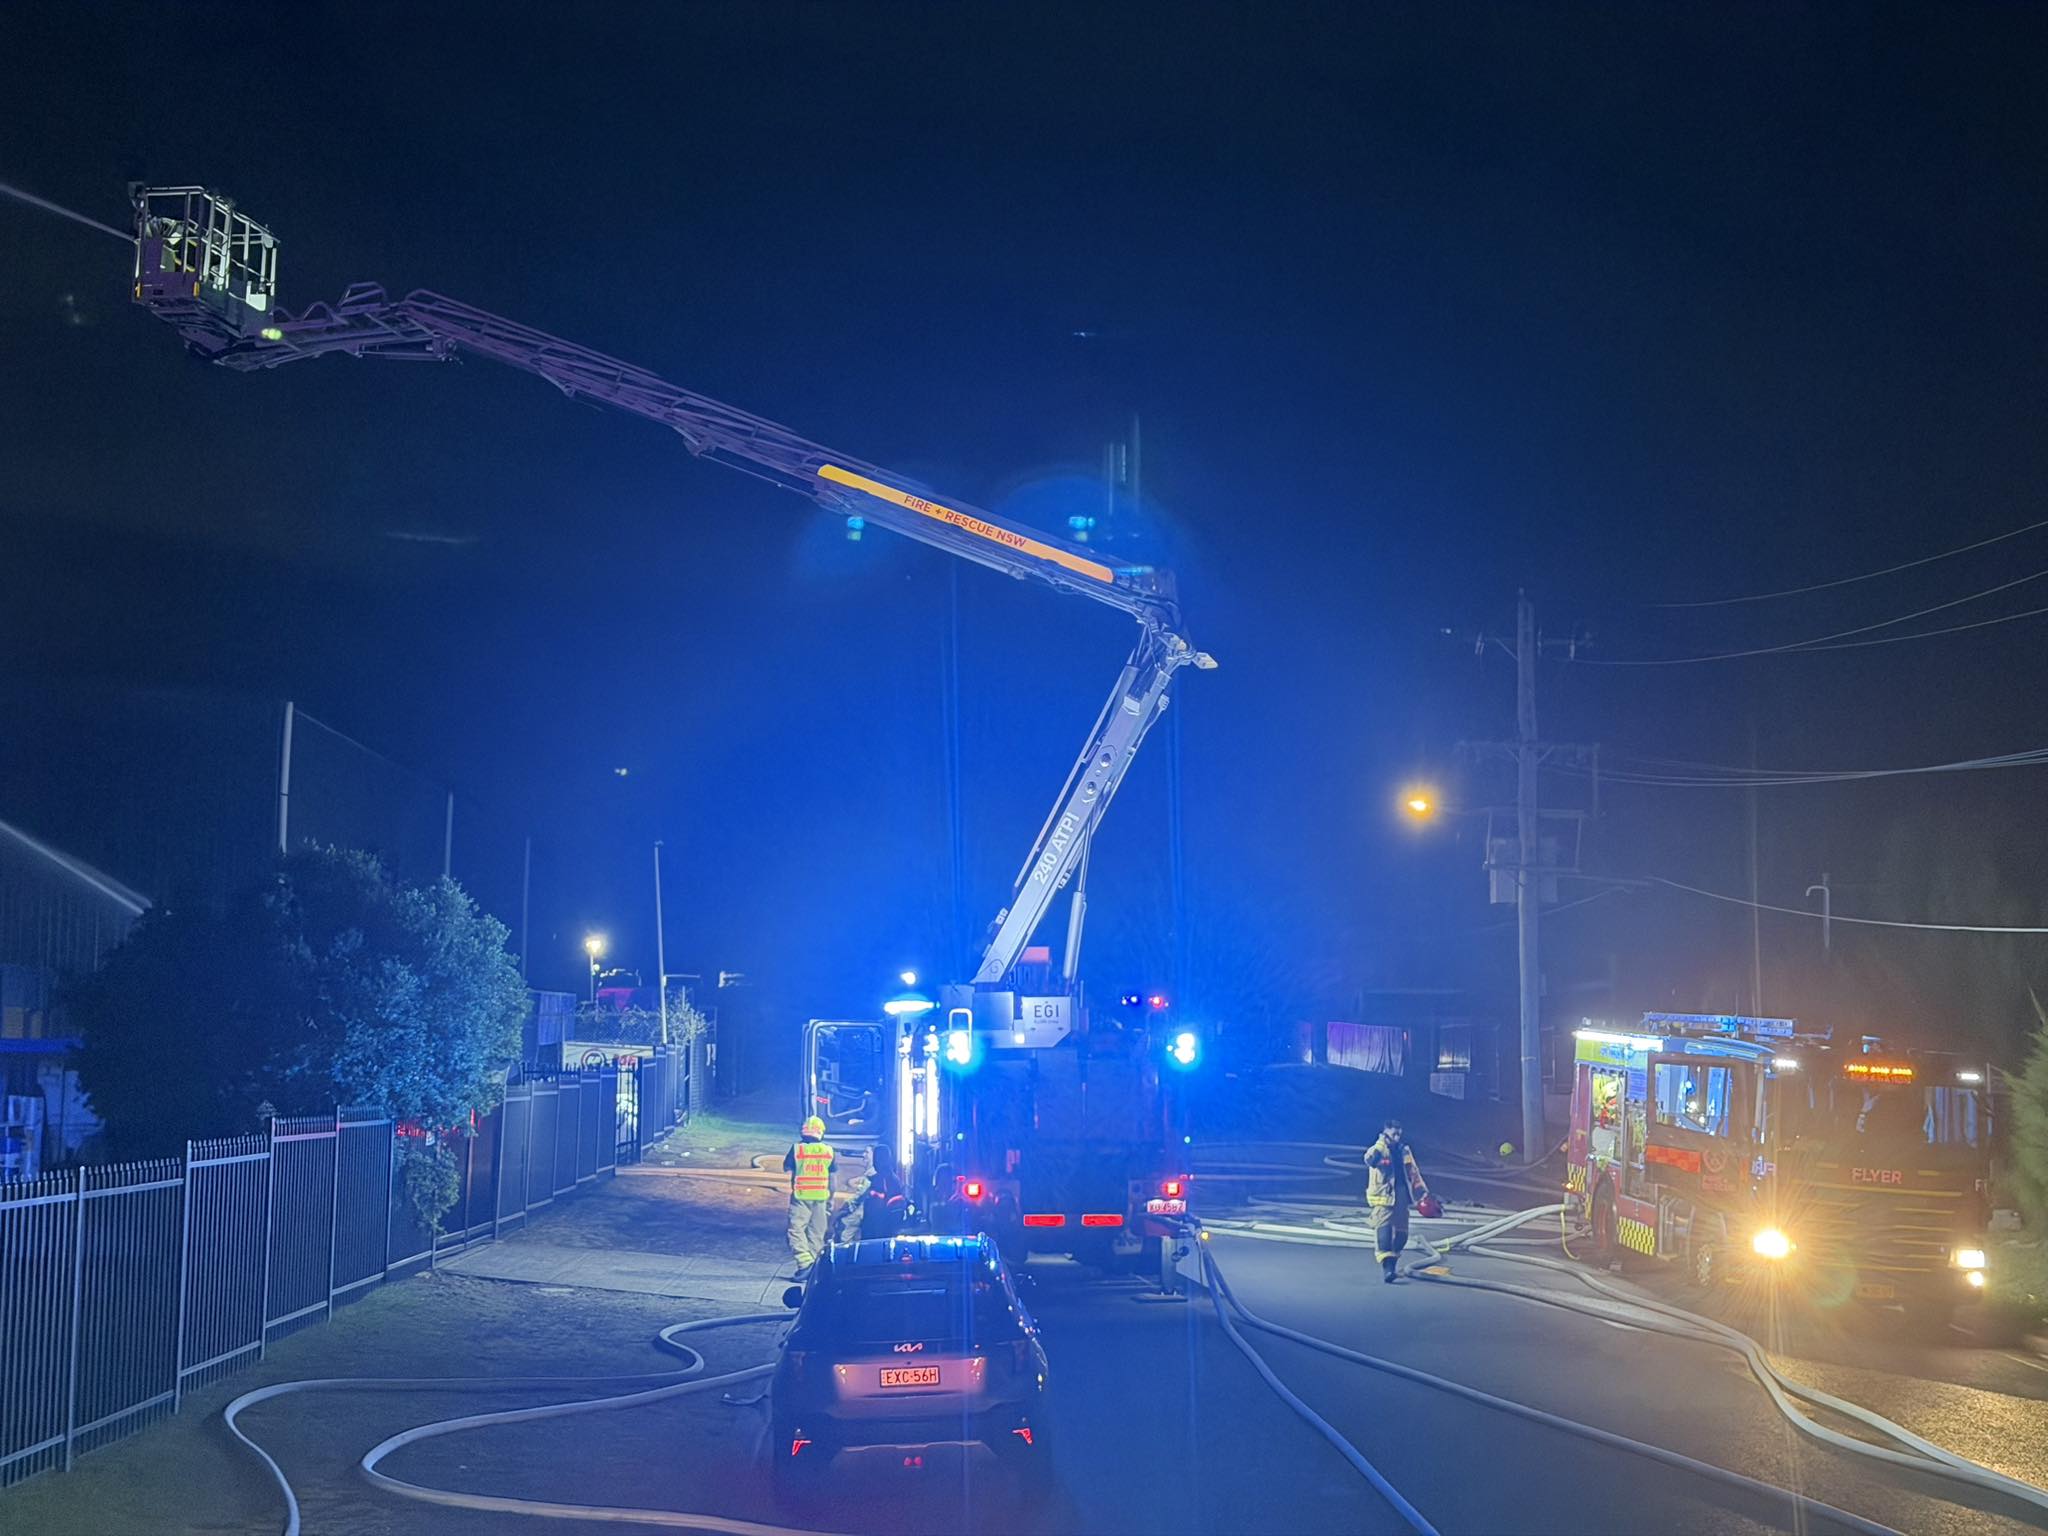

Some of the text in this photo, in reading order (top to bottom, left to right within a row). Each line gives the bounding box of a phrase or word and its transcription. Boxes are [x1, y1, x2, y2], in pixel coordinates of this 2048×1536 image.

[904, 495, 933, 513] FIRE
[944, 510, 994, 537] RESCUE
[996, 530, 1027, 547] NSW
[1034, 852, 1058, 885] 240
[1034, 1004, 1059, 1018] EGI
[1852, 1167, 1903, 1184] FLYER
